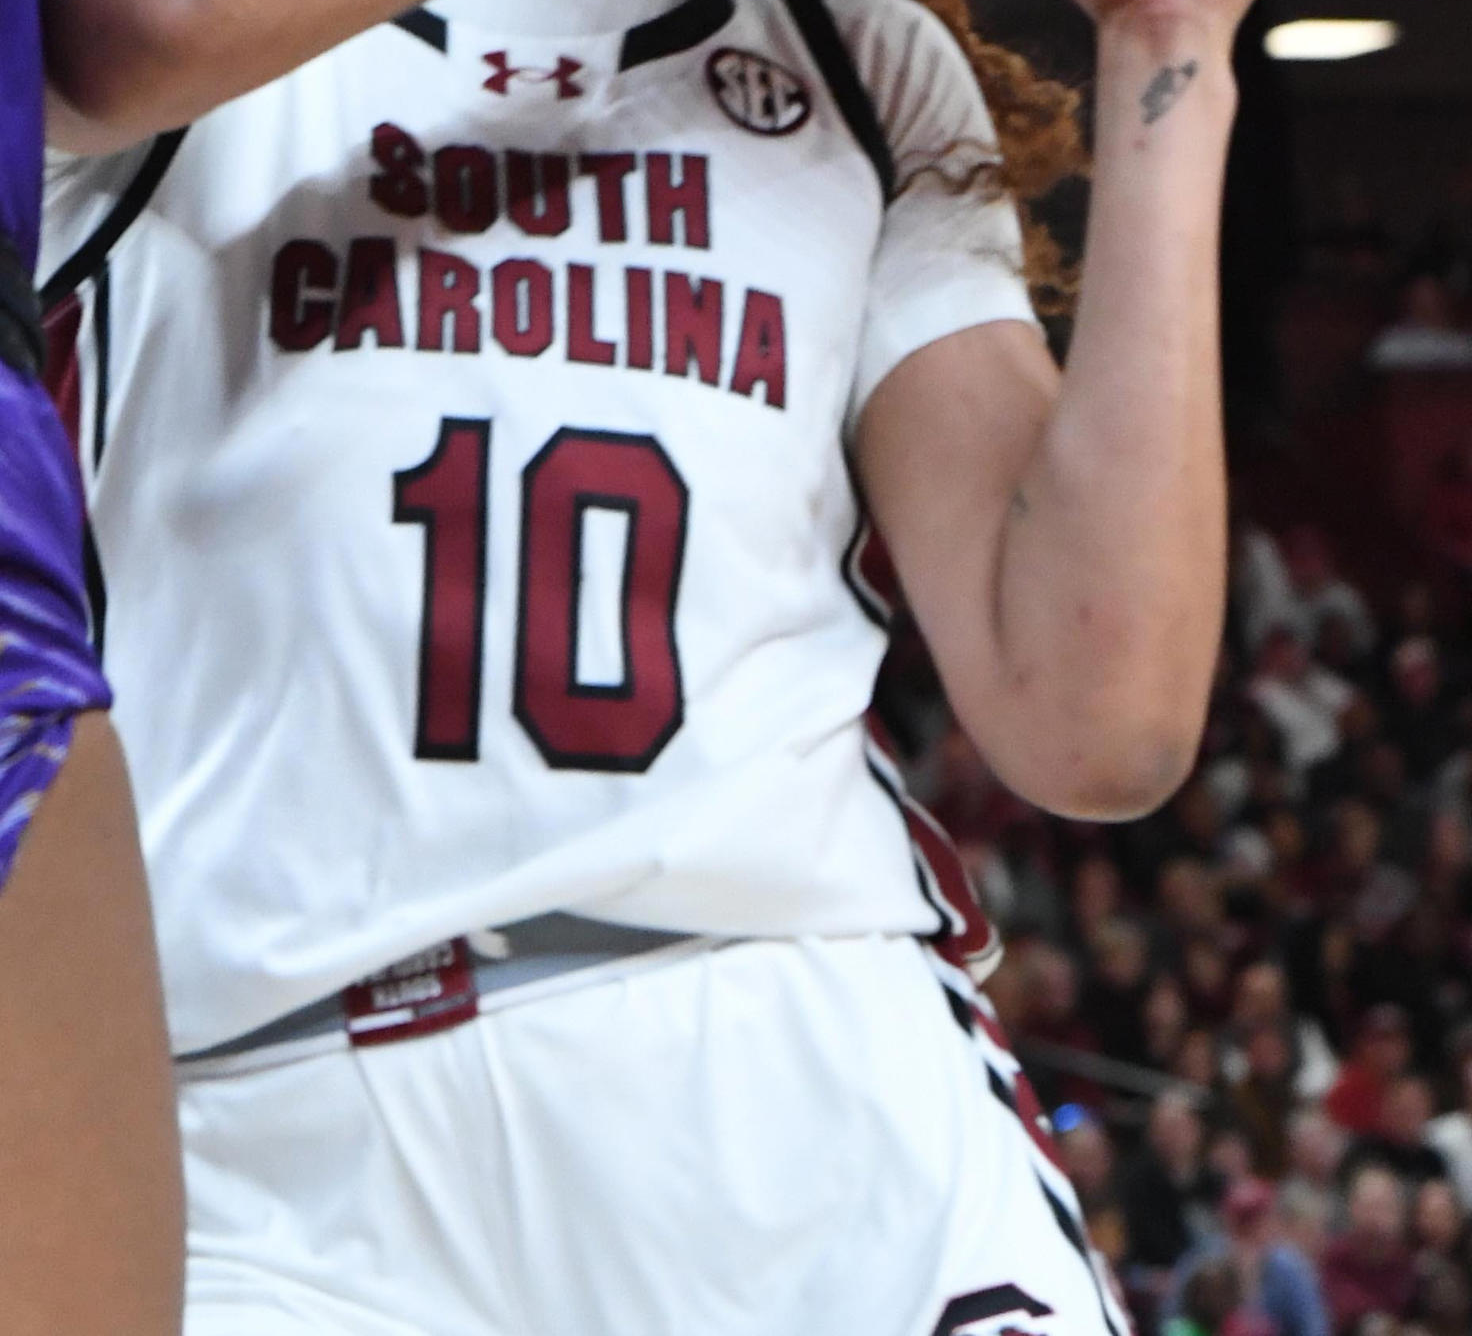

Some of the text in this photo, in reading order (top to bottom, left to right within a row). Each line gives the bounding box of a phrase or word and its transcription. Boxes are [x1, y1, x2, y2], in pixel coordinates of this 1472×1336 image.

[368, 121, 711, 251] SOUTH
[267, 236, 787, 412] CAROLINA
[391, 415, 690, 774] 10
